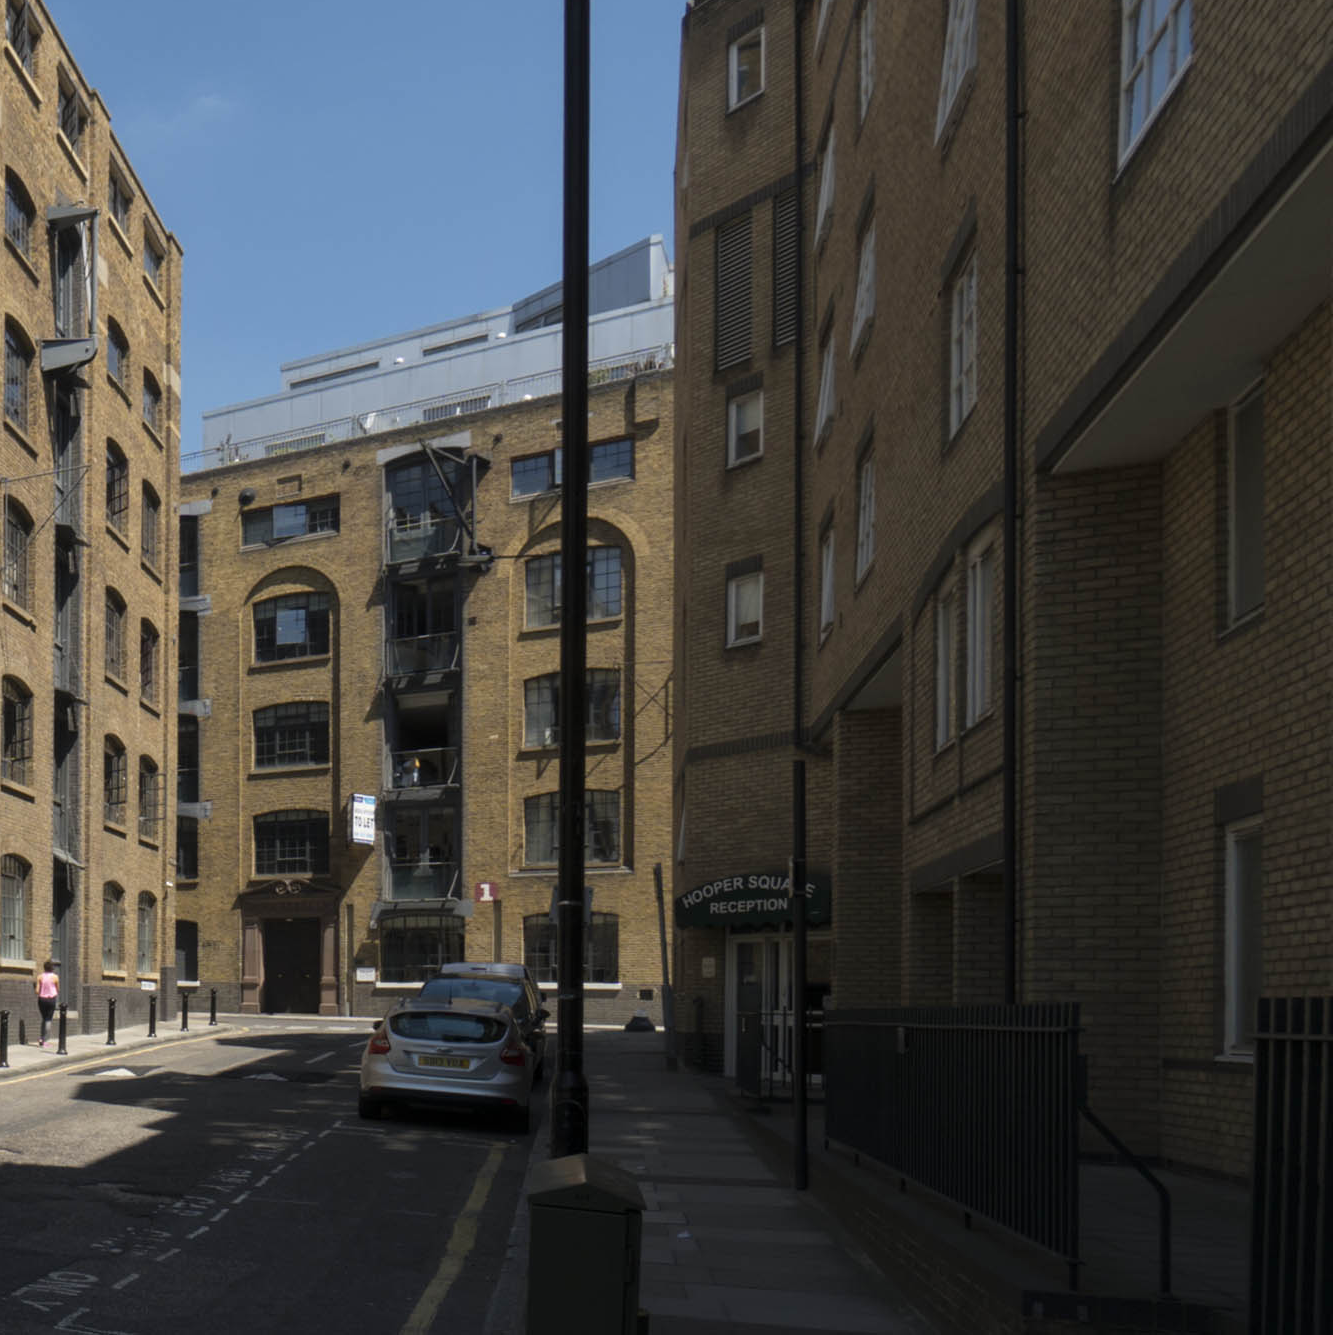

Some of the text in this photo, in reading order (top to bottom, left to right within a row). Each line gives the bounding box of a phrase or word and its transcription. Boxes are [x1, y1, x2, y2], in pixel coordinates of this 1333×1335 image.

[354, 815, 374, 829] TO LET
[479, 883, 494, 902] 1
[681, 875, 816, 909] HOOPER SQUAE
[709, 897, 789, 915] RECEPTION
[11, 1270, 99, 1312] ONLY
